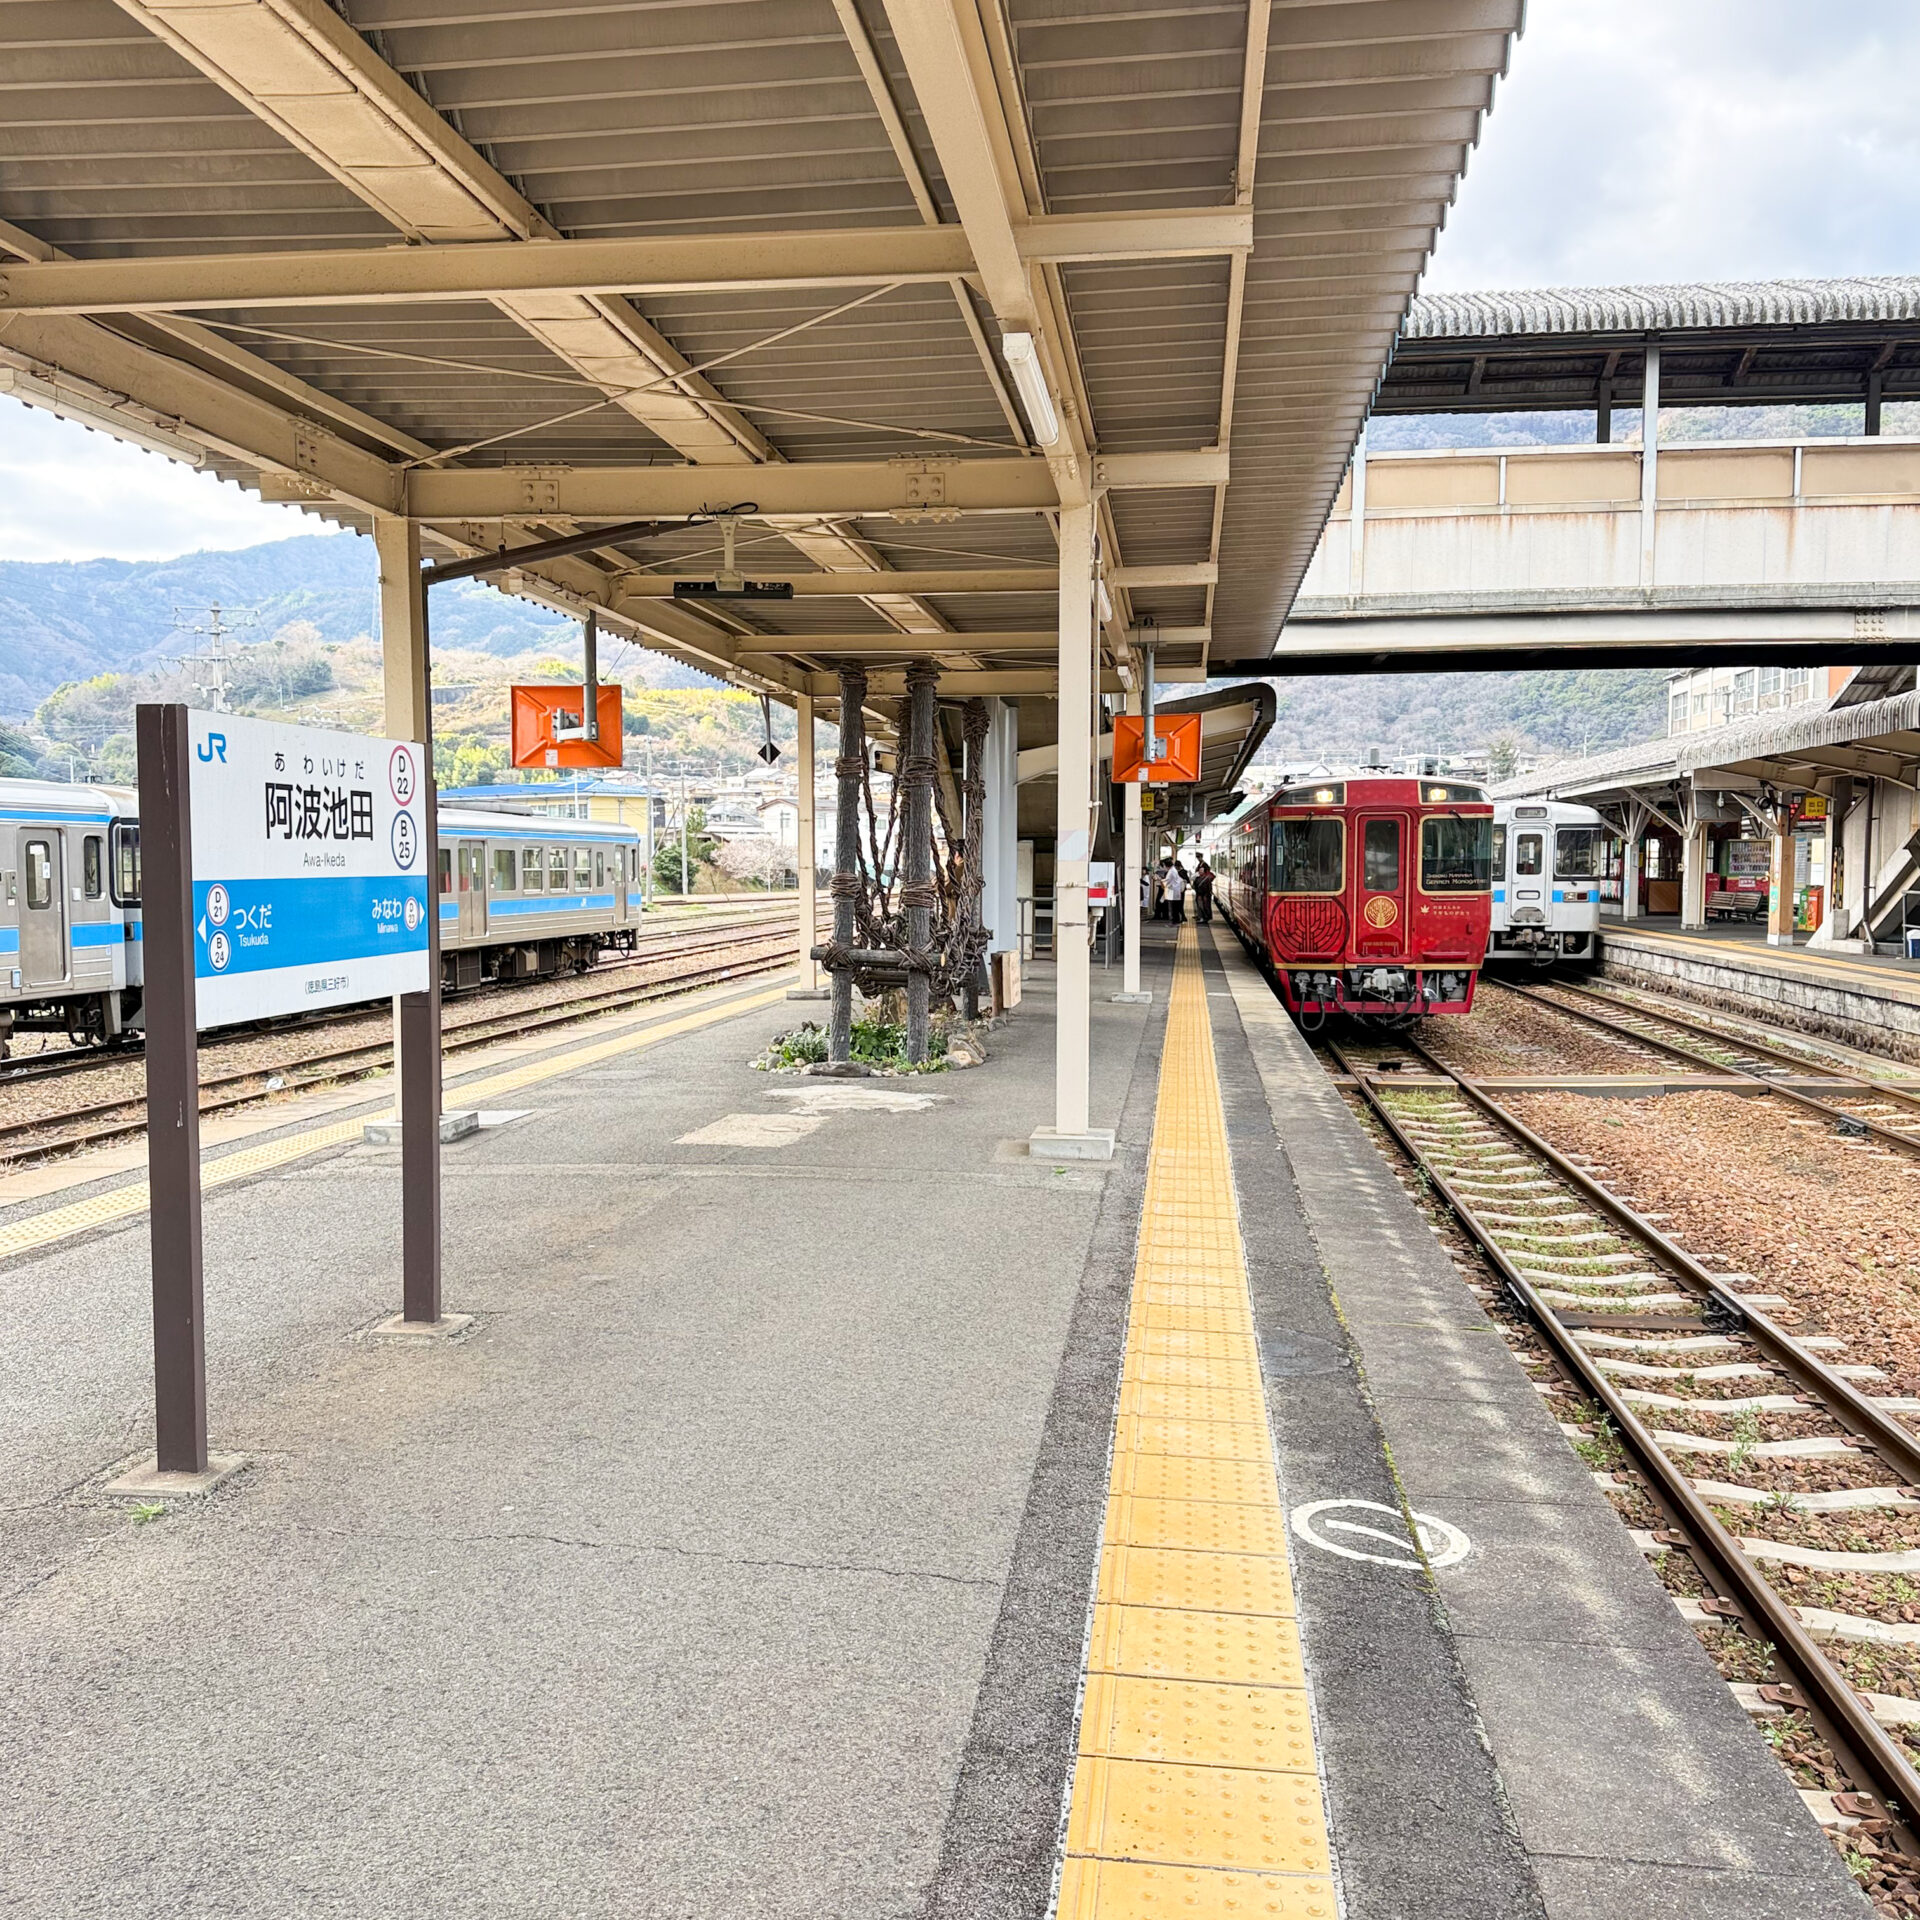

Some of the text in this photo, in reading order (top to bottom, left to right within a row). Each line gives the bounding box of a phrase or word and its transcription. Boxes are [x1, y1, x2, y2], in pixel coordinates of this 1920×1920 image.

[197, 732, 227, 763] JR
[274, 752, 365, 780] あわいけだ
[398, 755, 406, 773] D
[397, 777, 409, 795] 22
[265, 782, 373, 841] 阿波池田
[400, 820, 408, 837] B
[399, 842, 410, 859] 25
[303, 852, 346, 867] Awa-Ikeda
[215, 891, 222, 903] D
[213, 906, 223, 918] 21
[233, 904, 273, 930] つくだ
[371, 898, 403, 919] みなわ
[377, 922, 399, 933] Minawa
[216, 937, 223, 949] B
[238, 932, 270, 947] Tsukuda
[215, 951, 225, 963] 24
